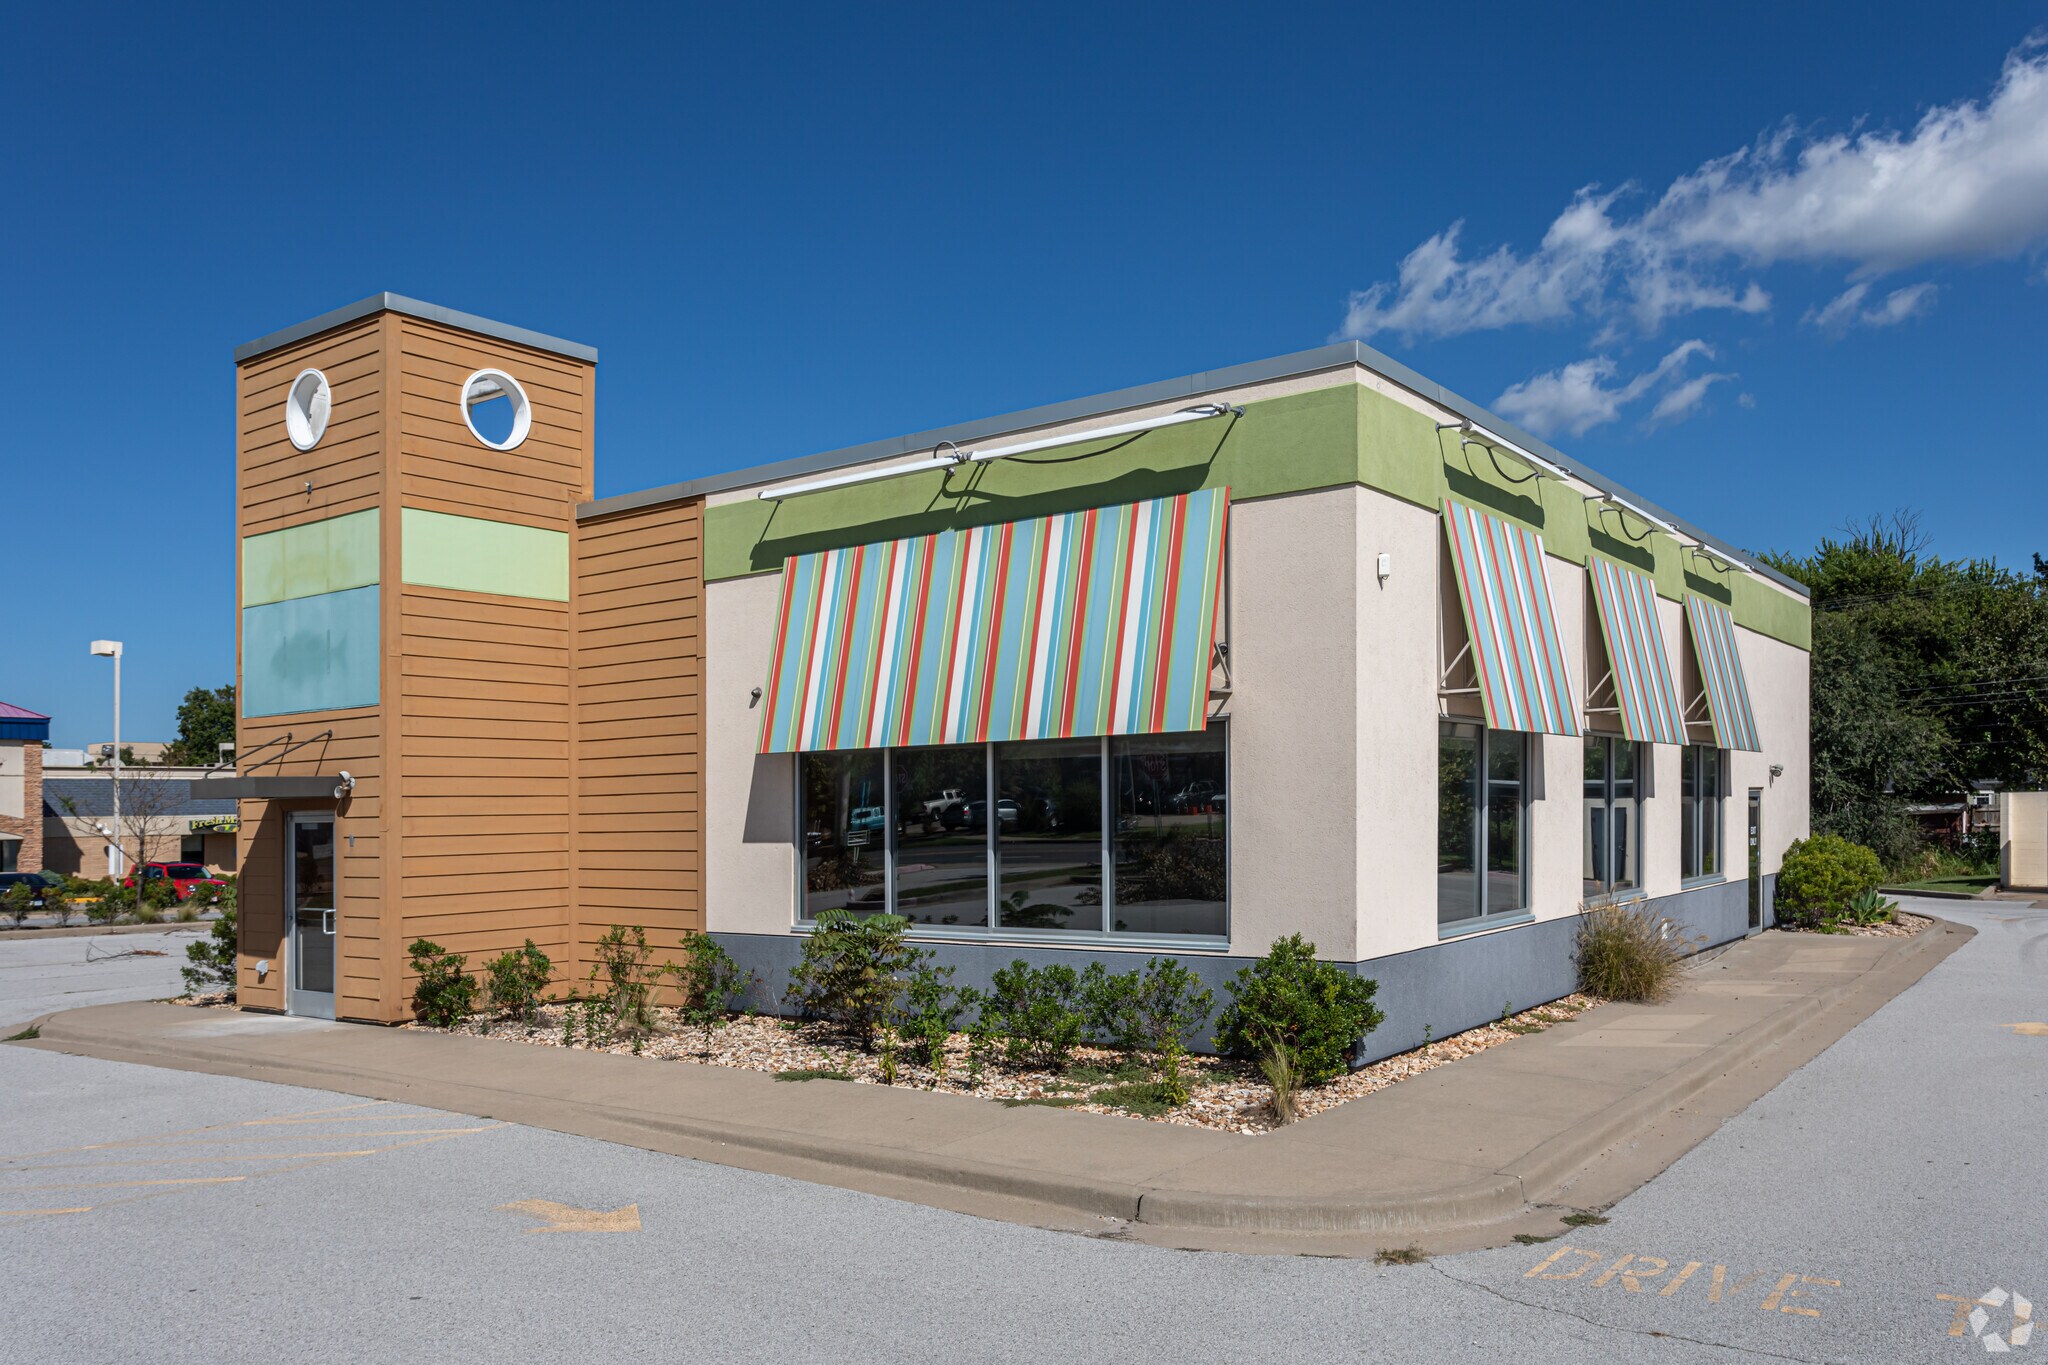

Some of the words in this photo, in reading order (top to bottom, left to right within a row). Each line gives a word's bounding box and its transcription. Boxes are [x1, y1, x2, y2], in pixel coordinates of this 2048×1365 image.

[191, 815, 222, 830] Fresh
[224, 815, 236, 824] M
[1523, 1245, 1841, 1318] DRIVE
